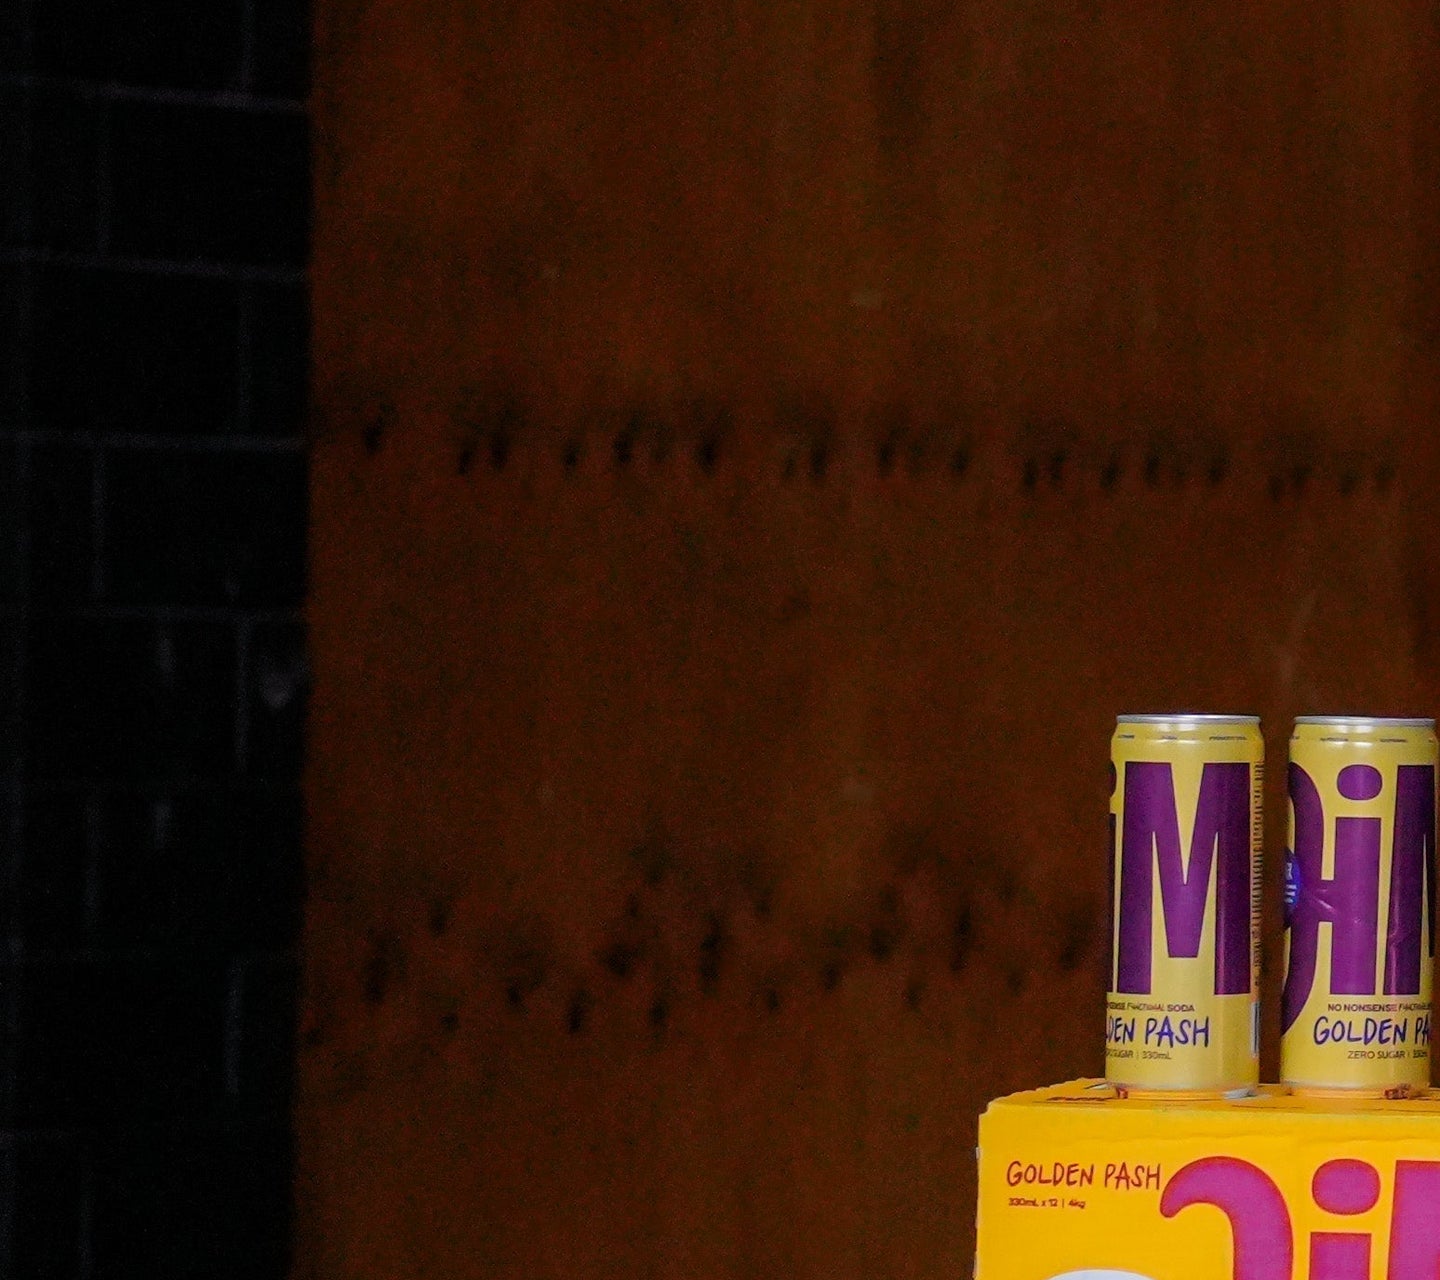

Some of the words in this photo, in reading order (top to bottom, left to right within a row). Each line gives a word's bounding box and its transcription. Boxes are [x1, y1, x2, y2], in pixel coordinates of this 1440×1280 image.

[1328, 1004, 1341, 1012] NO
[1344, 1003, 1398, 1012] NONSENSE
[1145, 1015, 1209, 1048] PASH
[1313, 1015, 1406, 1046] GOLDEN
[1415, 1014, 1431, 1046] PA
[1348, 1051, 1375, 1059] ZERO
[1377, 1051, 1405, 1059] SUGAR
[1006, 1160, 1095, 1188] GOLDEN
[1104, 1162, 1162, 1190] PASH
